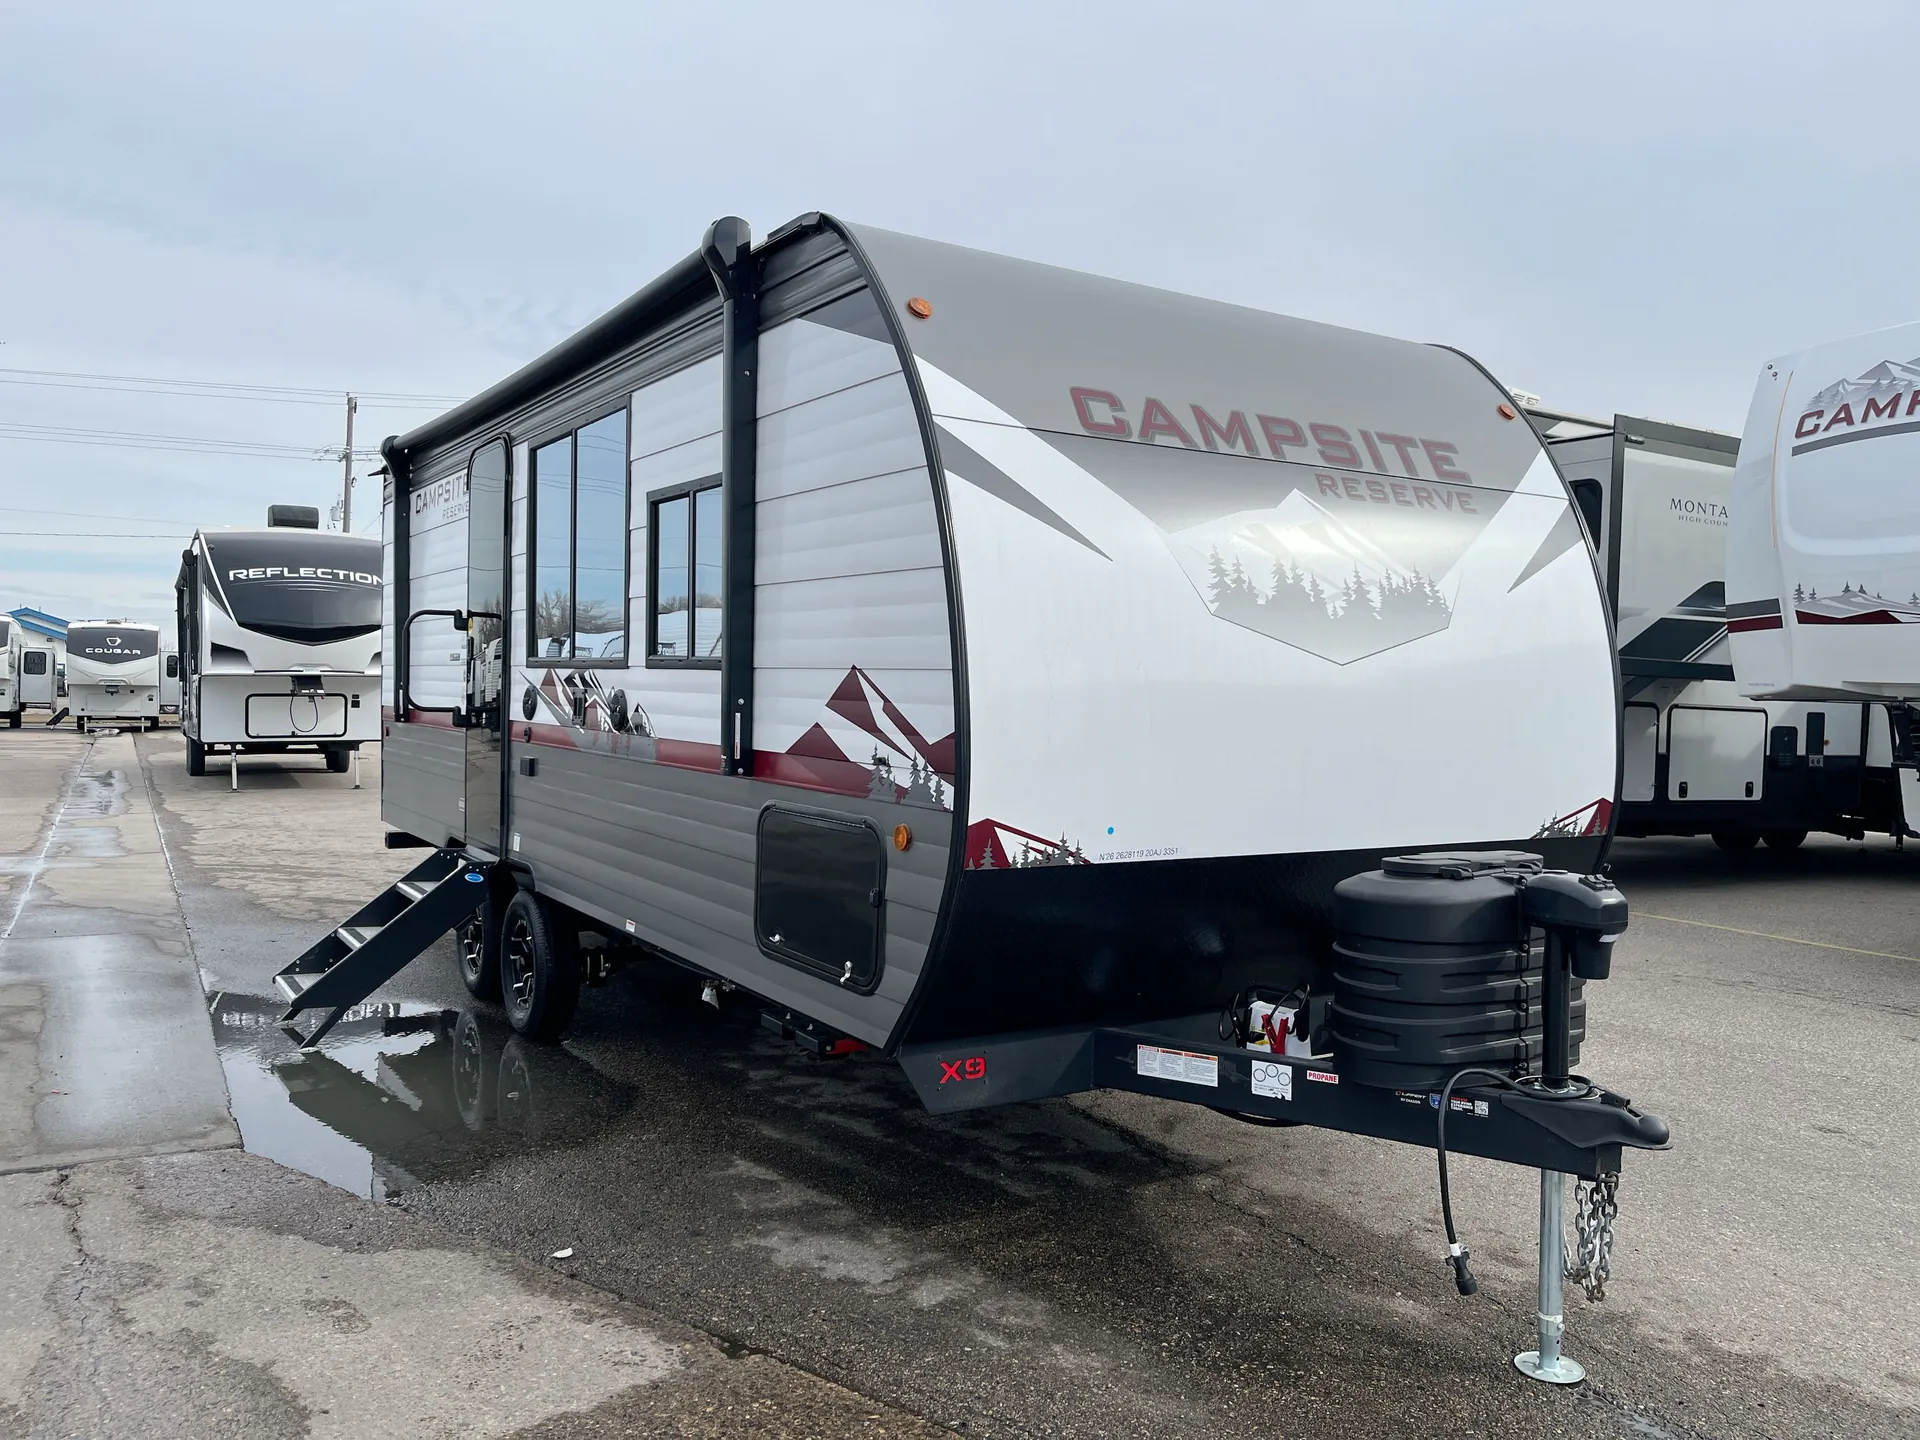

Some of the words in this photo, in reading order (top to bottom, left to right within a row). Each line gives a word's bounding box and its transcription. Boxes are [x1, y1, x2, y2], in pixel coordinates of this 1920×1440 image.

[1069, 386, 1472, 484] CAMPSITE
[416, 473, 469, 515] CAMPSITE
[1314, 472, 1478, 515] RESERVE
[1669, 497, 1728, 519] MONTA
[1678, 515, 1701, 524] HIGH
[85, 647, 141, 655] COUGAR
[940, 1057, 986, 1085] X9
[1308, 1072, 1338, 1083] PROPANE
